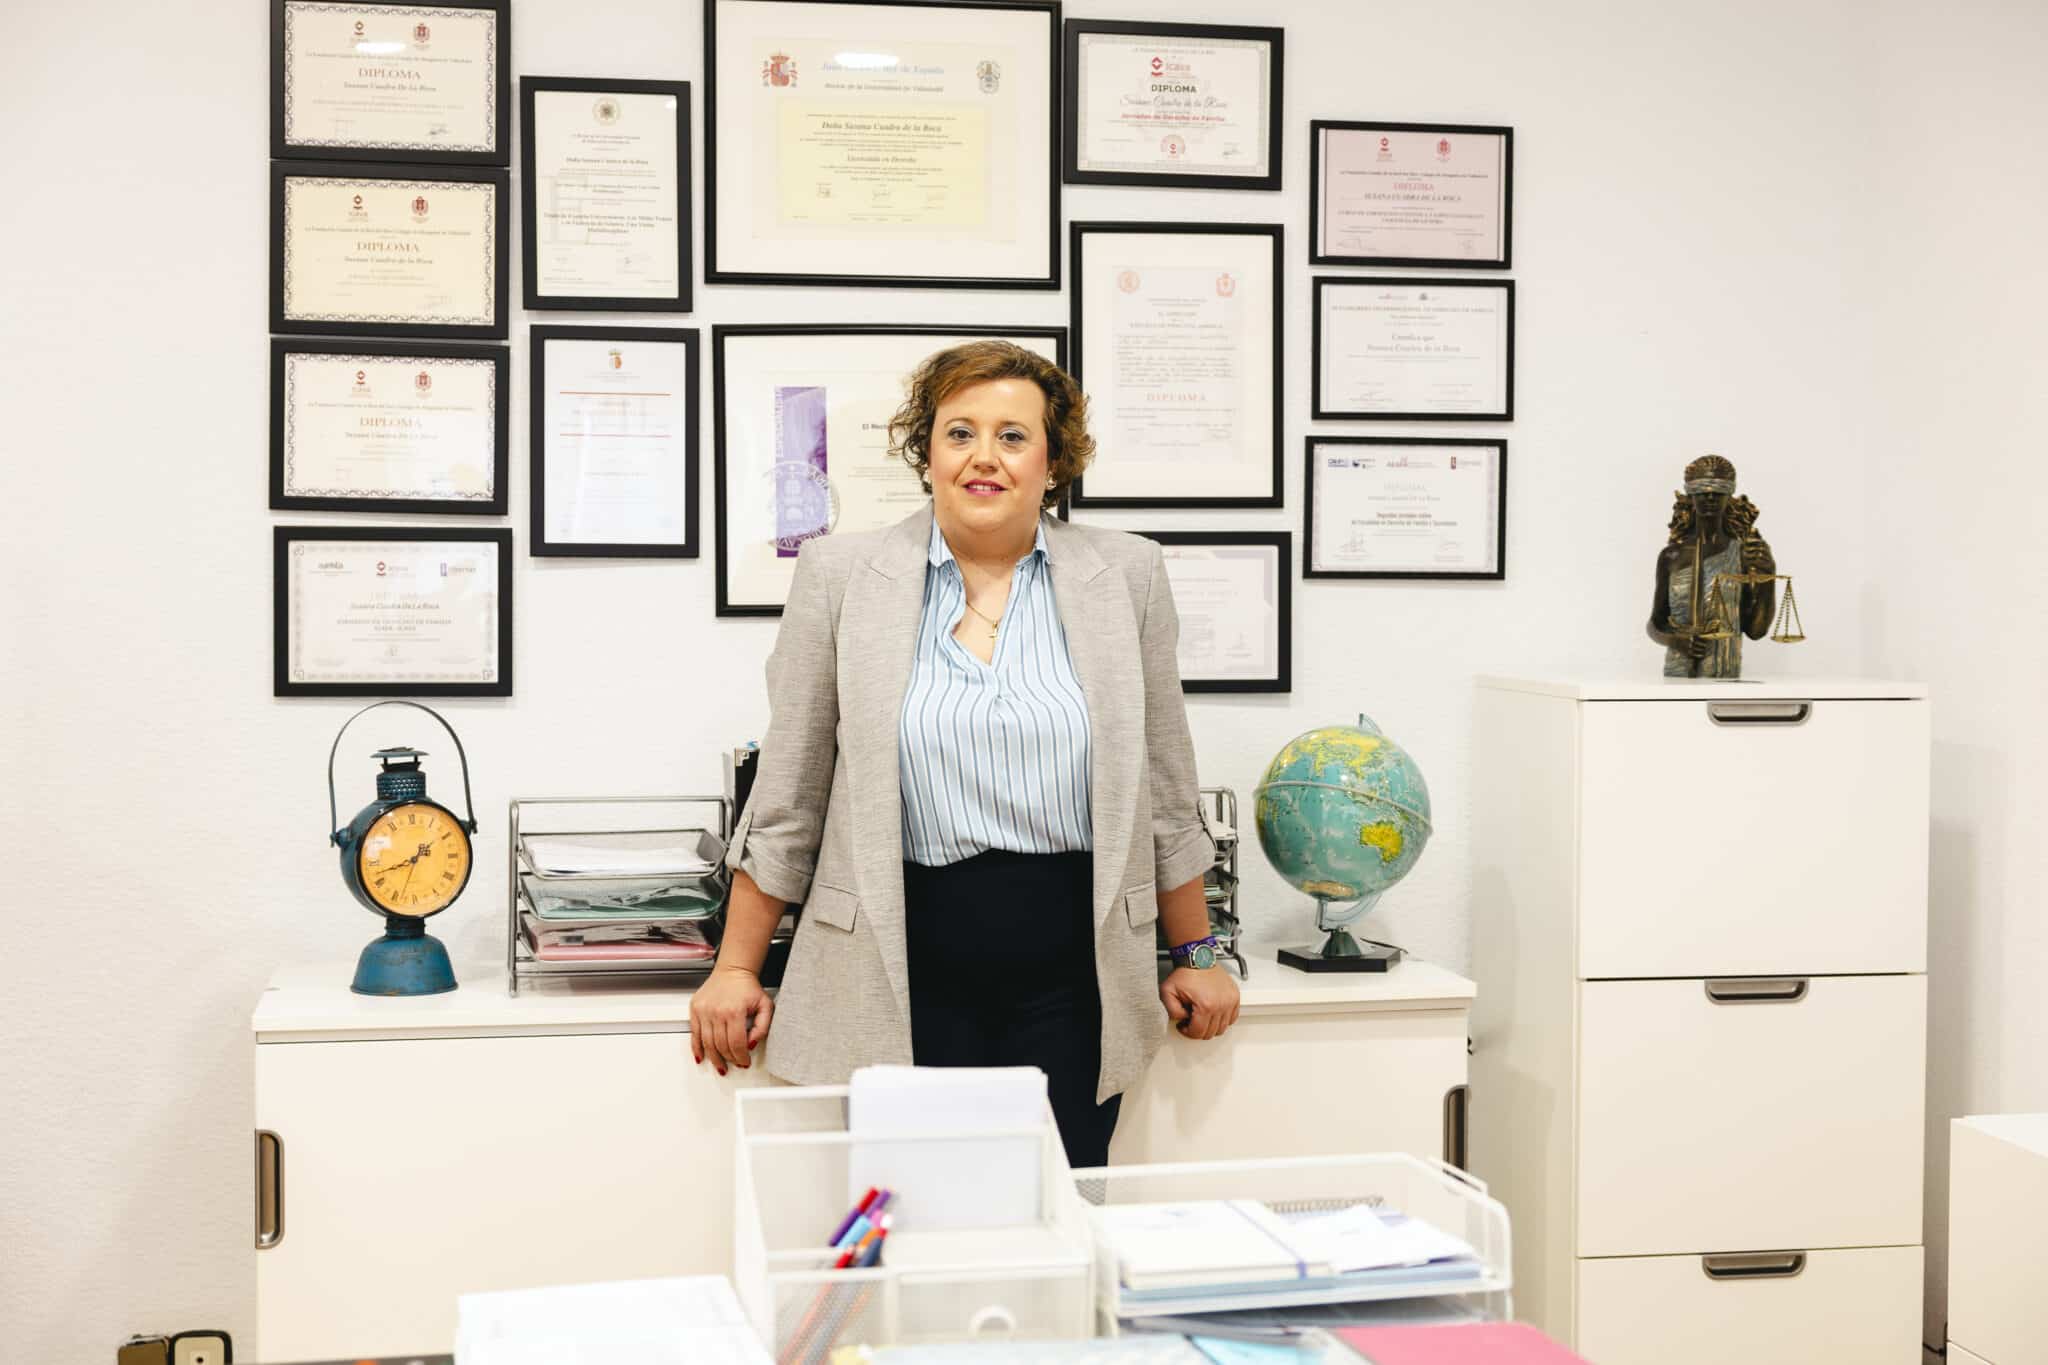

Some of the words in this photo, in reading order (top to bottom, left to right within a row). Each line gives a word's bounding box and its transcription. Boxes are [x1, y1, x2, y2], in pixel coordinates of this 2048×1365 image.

[359, 67, 422, 81] DIPLOMA
[1151, 84, 1198, 93] DIPLOMA
[357, 241, 420, 254] DIPLOMA
[360, 415, 423, 428] DIPLOMA
